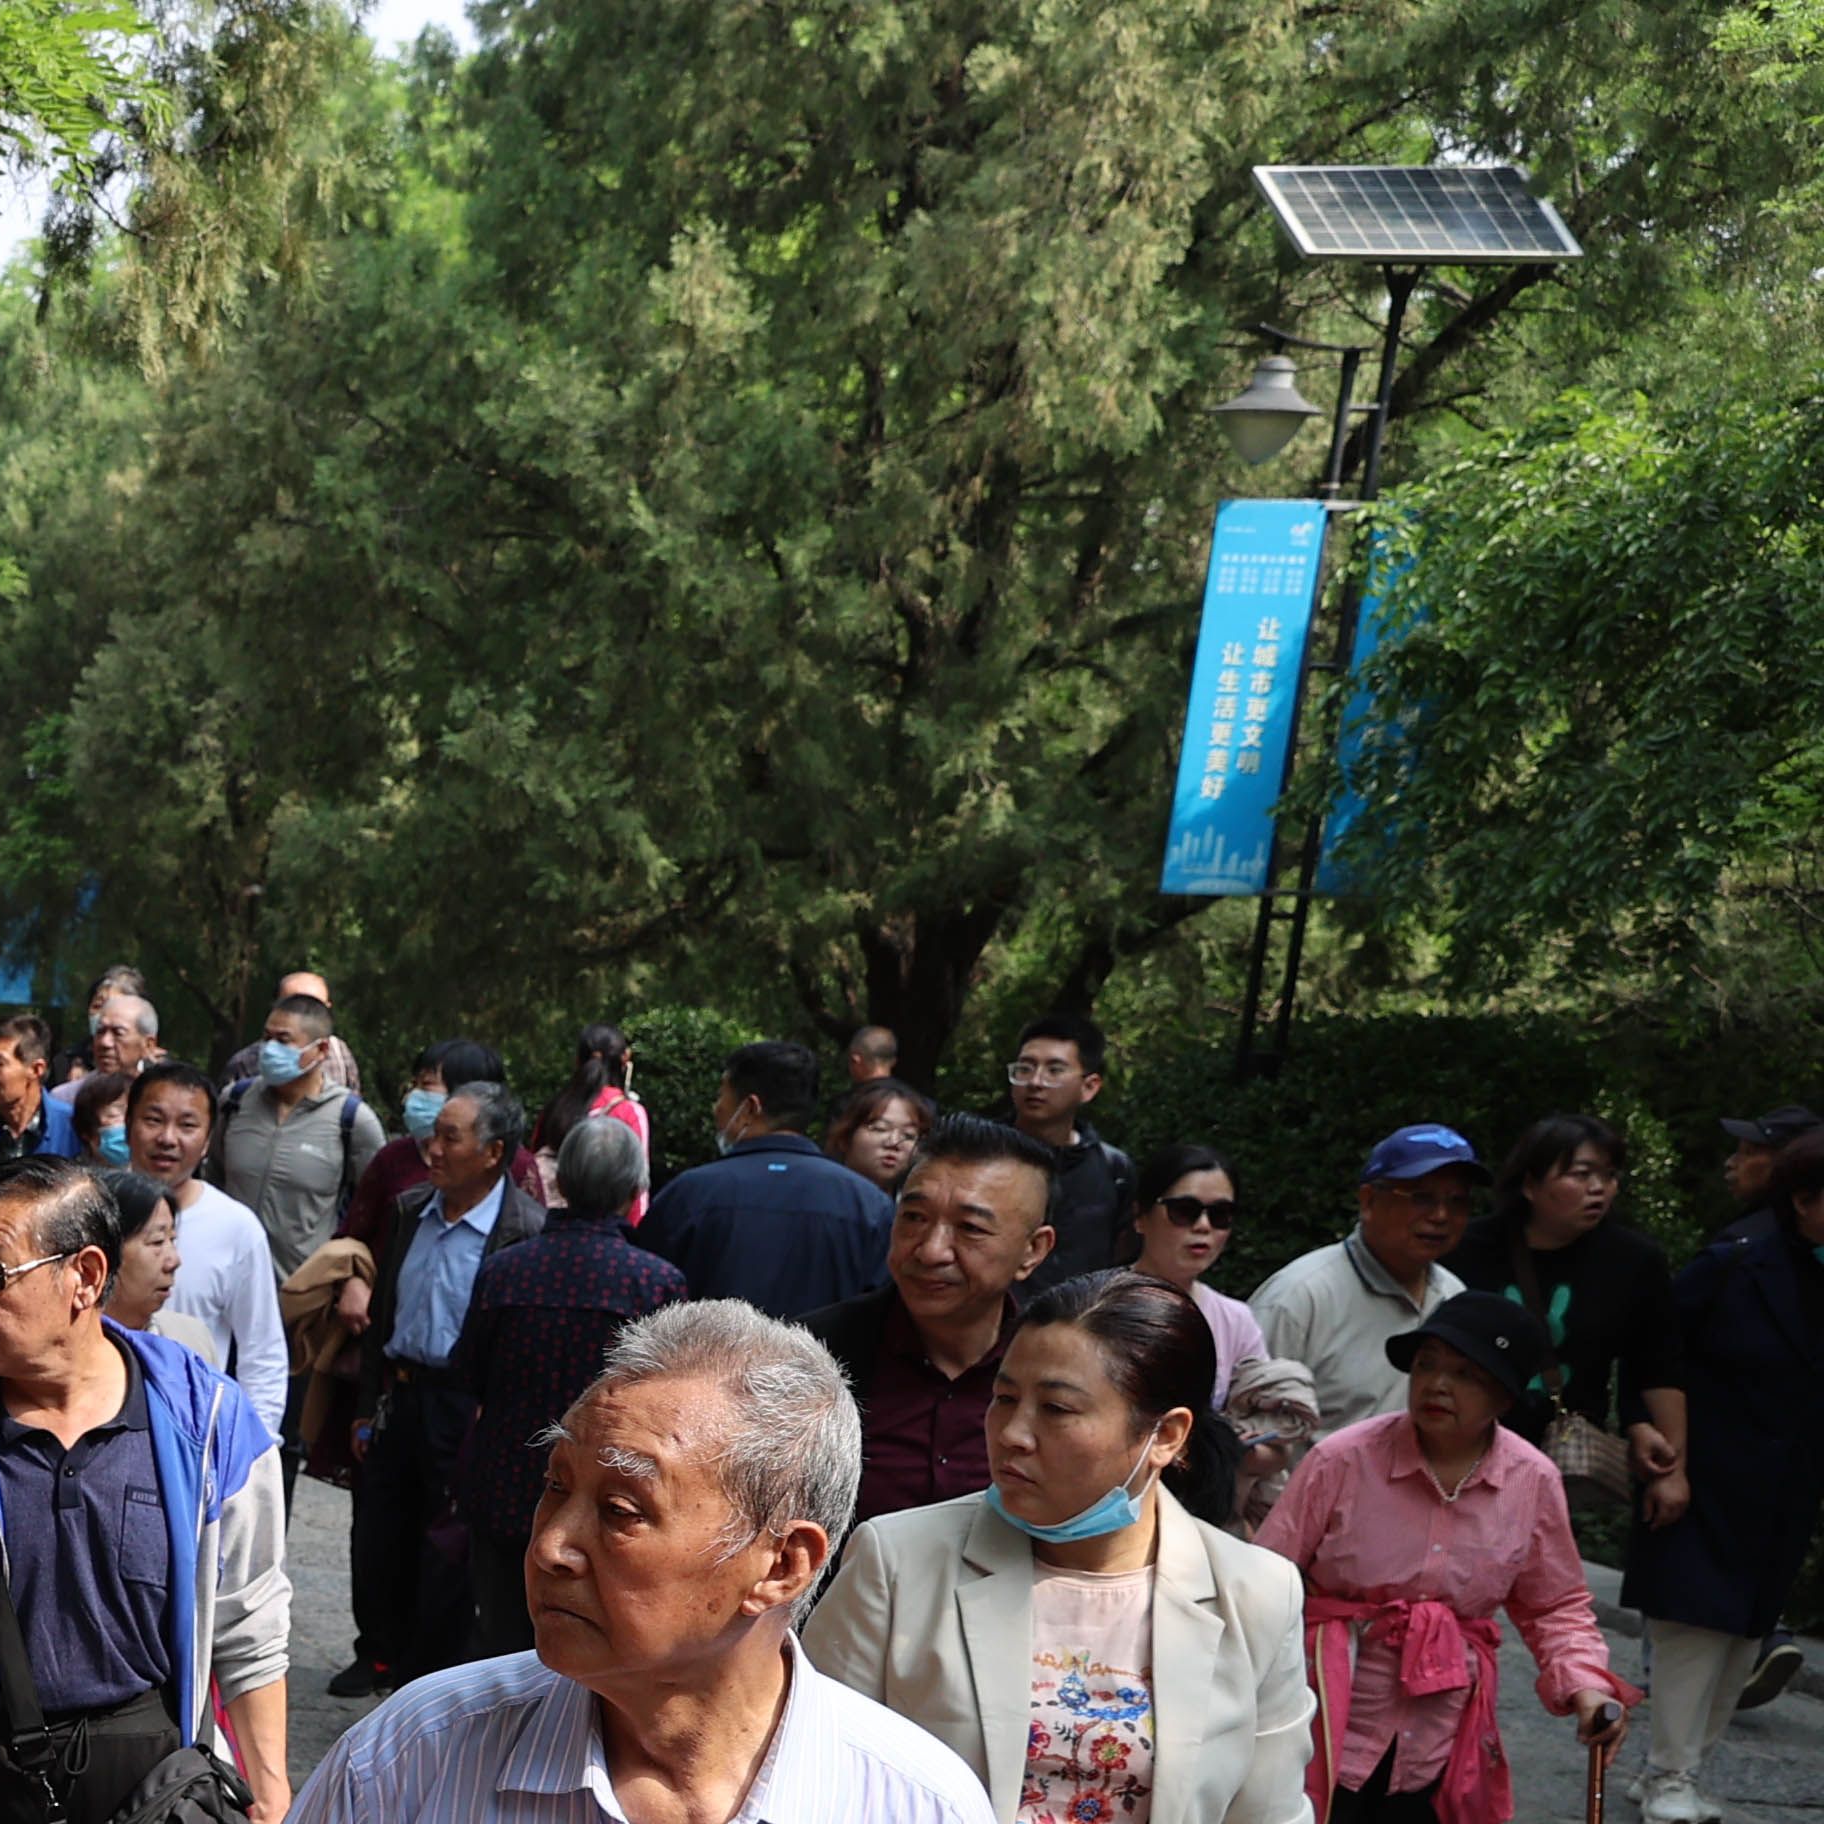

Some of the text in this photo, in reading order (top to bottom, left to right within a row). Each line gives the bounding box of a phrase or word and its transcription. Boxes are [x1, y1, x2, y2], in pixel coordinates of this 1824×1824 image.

[1199, 641, 1247, 801] 让生活更美好
[1236, 616, 1282, 776] 让城市更文明
